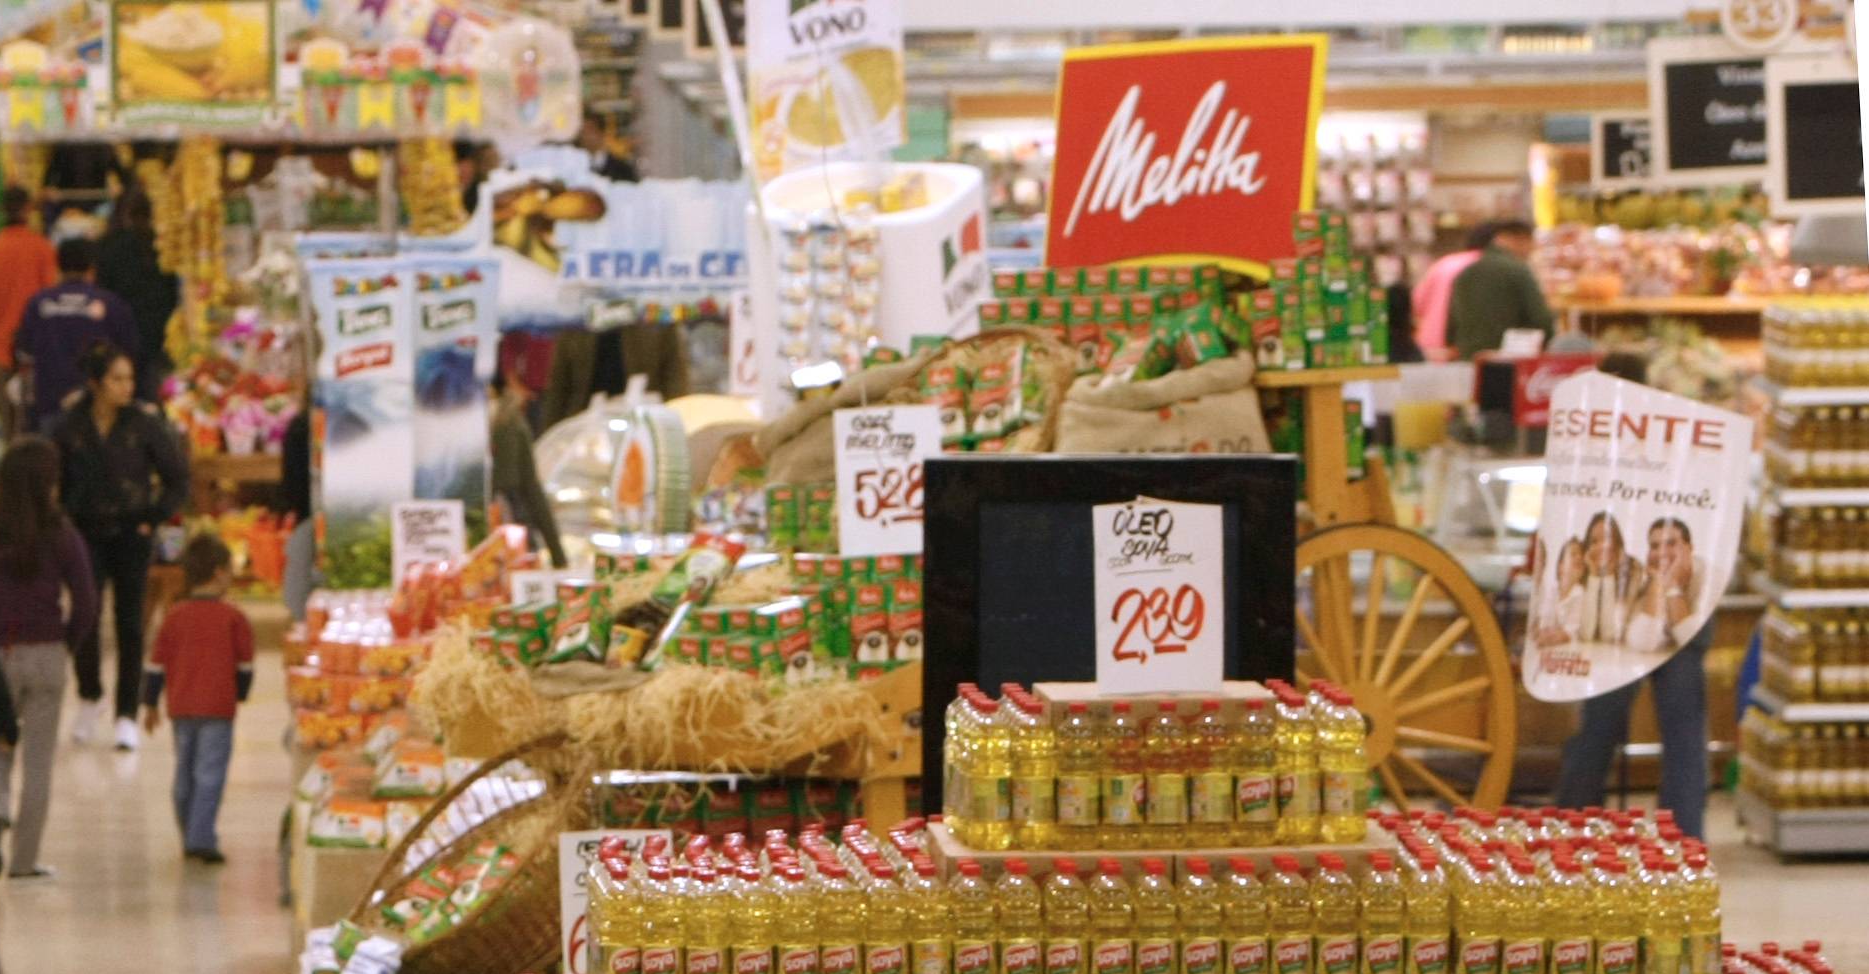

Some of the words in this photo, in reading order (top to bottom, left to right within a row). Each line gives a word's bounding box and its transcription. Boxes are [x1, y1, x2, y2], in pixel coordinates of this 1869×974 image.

[789, 6, 866, 45] VONO
[1064, 80, 1265, 239] Melitta
[1609, 480, 1650, 500] Por
[1653, 488, 1718, 510] você.
